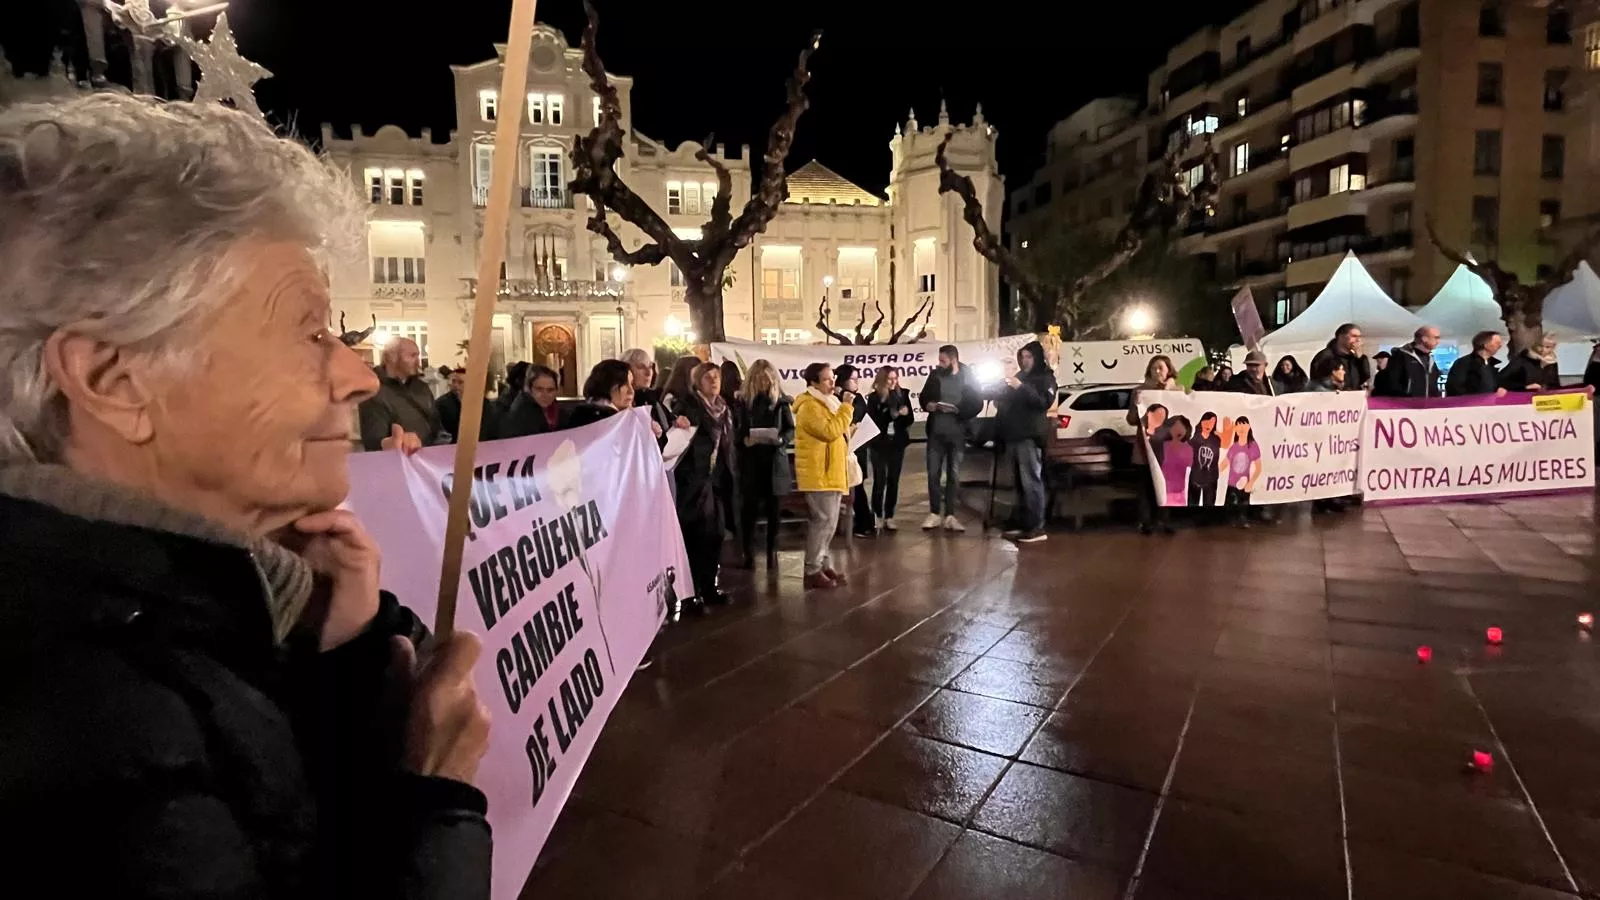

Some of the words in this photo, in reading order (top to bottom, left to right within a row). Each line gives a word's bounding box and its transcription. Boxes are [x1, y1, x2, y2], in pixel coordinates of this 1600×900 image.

[843, 353, 898, 365] BASTA
[903, 352, 925, 363] DE
[1122, 343, 1193, 355] SATUSONIC
[1274, 405, 1296, 427] Ni
[1300, 409, 1322, 427] una
[1327, 407, 1361, 427] meno
[1374, 417, 1418, 449] NO
[1424, 417, 1466, 447] MÁS
[1469, 418, 1577, 445] VIOLENCIA
[1272, 439, 1308, 459] vivas
[1314, 442, 1323, 462] y
[506, 454, 542, 511] LA
[1266, 474, 1294, 491] nos
[1301, 467, 1358, 494] queremo
[1367, 466, 1450, 491] CONTRA
[1457, 464, 1494, 487] LAS
[1497, 457, 1587, 484] MUJERES
[467, 500, 609, 631] VERGÜENZA
[496, 582, 584, 715] CAMBIE
[524, 713, 557, 809] DE
[548, 647, 605, 755] LADO
